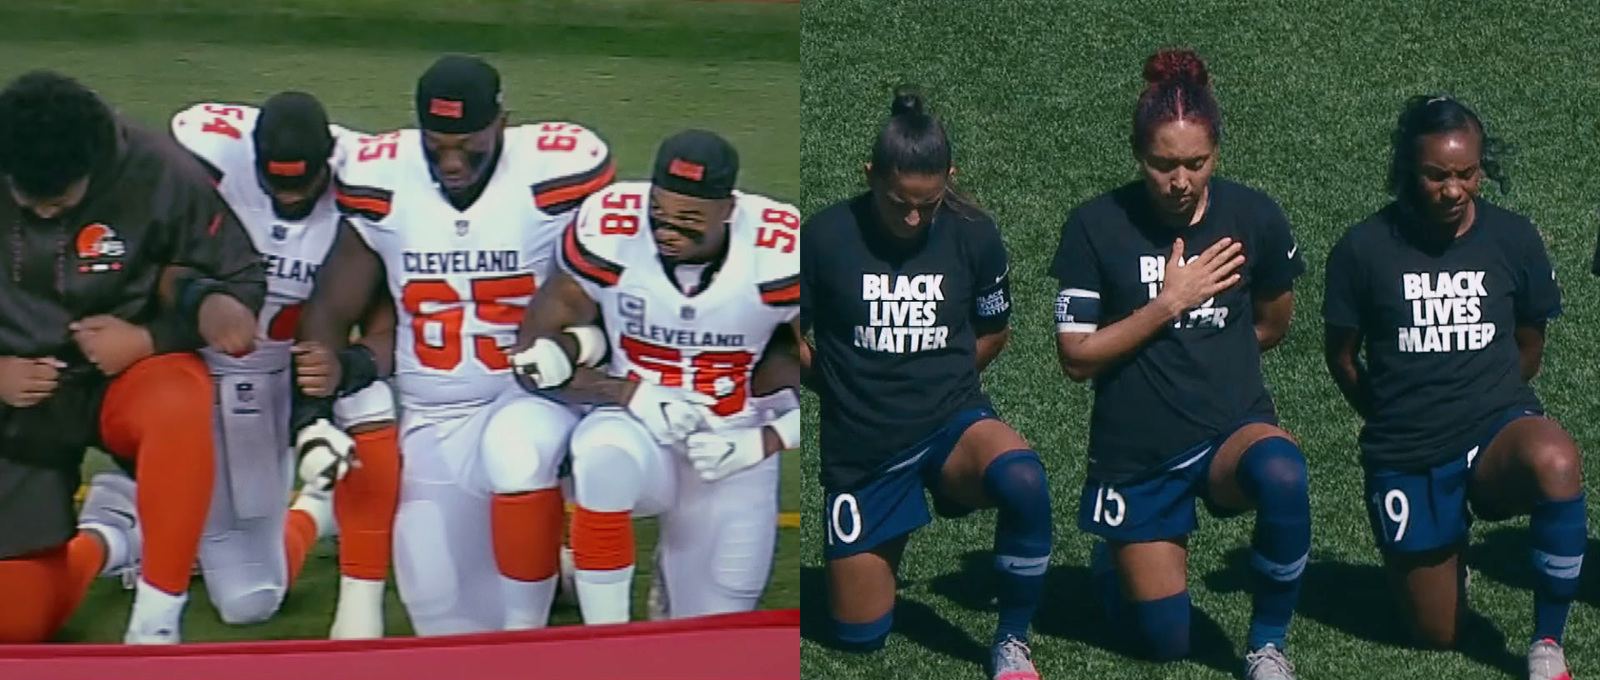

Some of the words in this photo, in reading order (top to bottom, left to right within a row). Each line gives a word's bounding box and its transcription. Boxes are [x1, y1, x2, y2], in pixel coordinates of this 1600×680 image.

[599, 192, 643, 236] 58
[756, 207, 800, 254] 58
[402, 250, 519, 274] CLEVELAND
[862, 273, 945, 301] BLACK
[1057, 296, 1071, 304] CK
[1402, 271, 1488, 300] BLACK
[402, 272, 536, 370] 65
[869, 300, 938, 327] LIVES
[1412, 297, 1483, 327] LIVES
[626, 322, 744, 347] CLEVELAND
[854, 325, 948, 353] MATTER
[1398, 323, 1496, 353] MATTER
[620, 332, 754, 417] 58
[1093, 487, 1127, 527] 15
